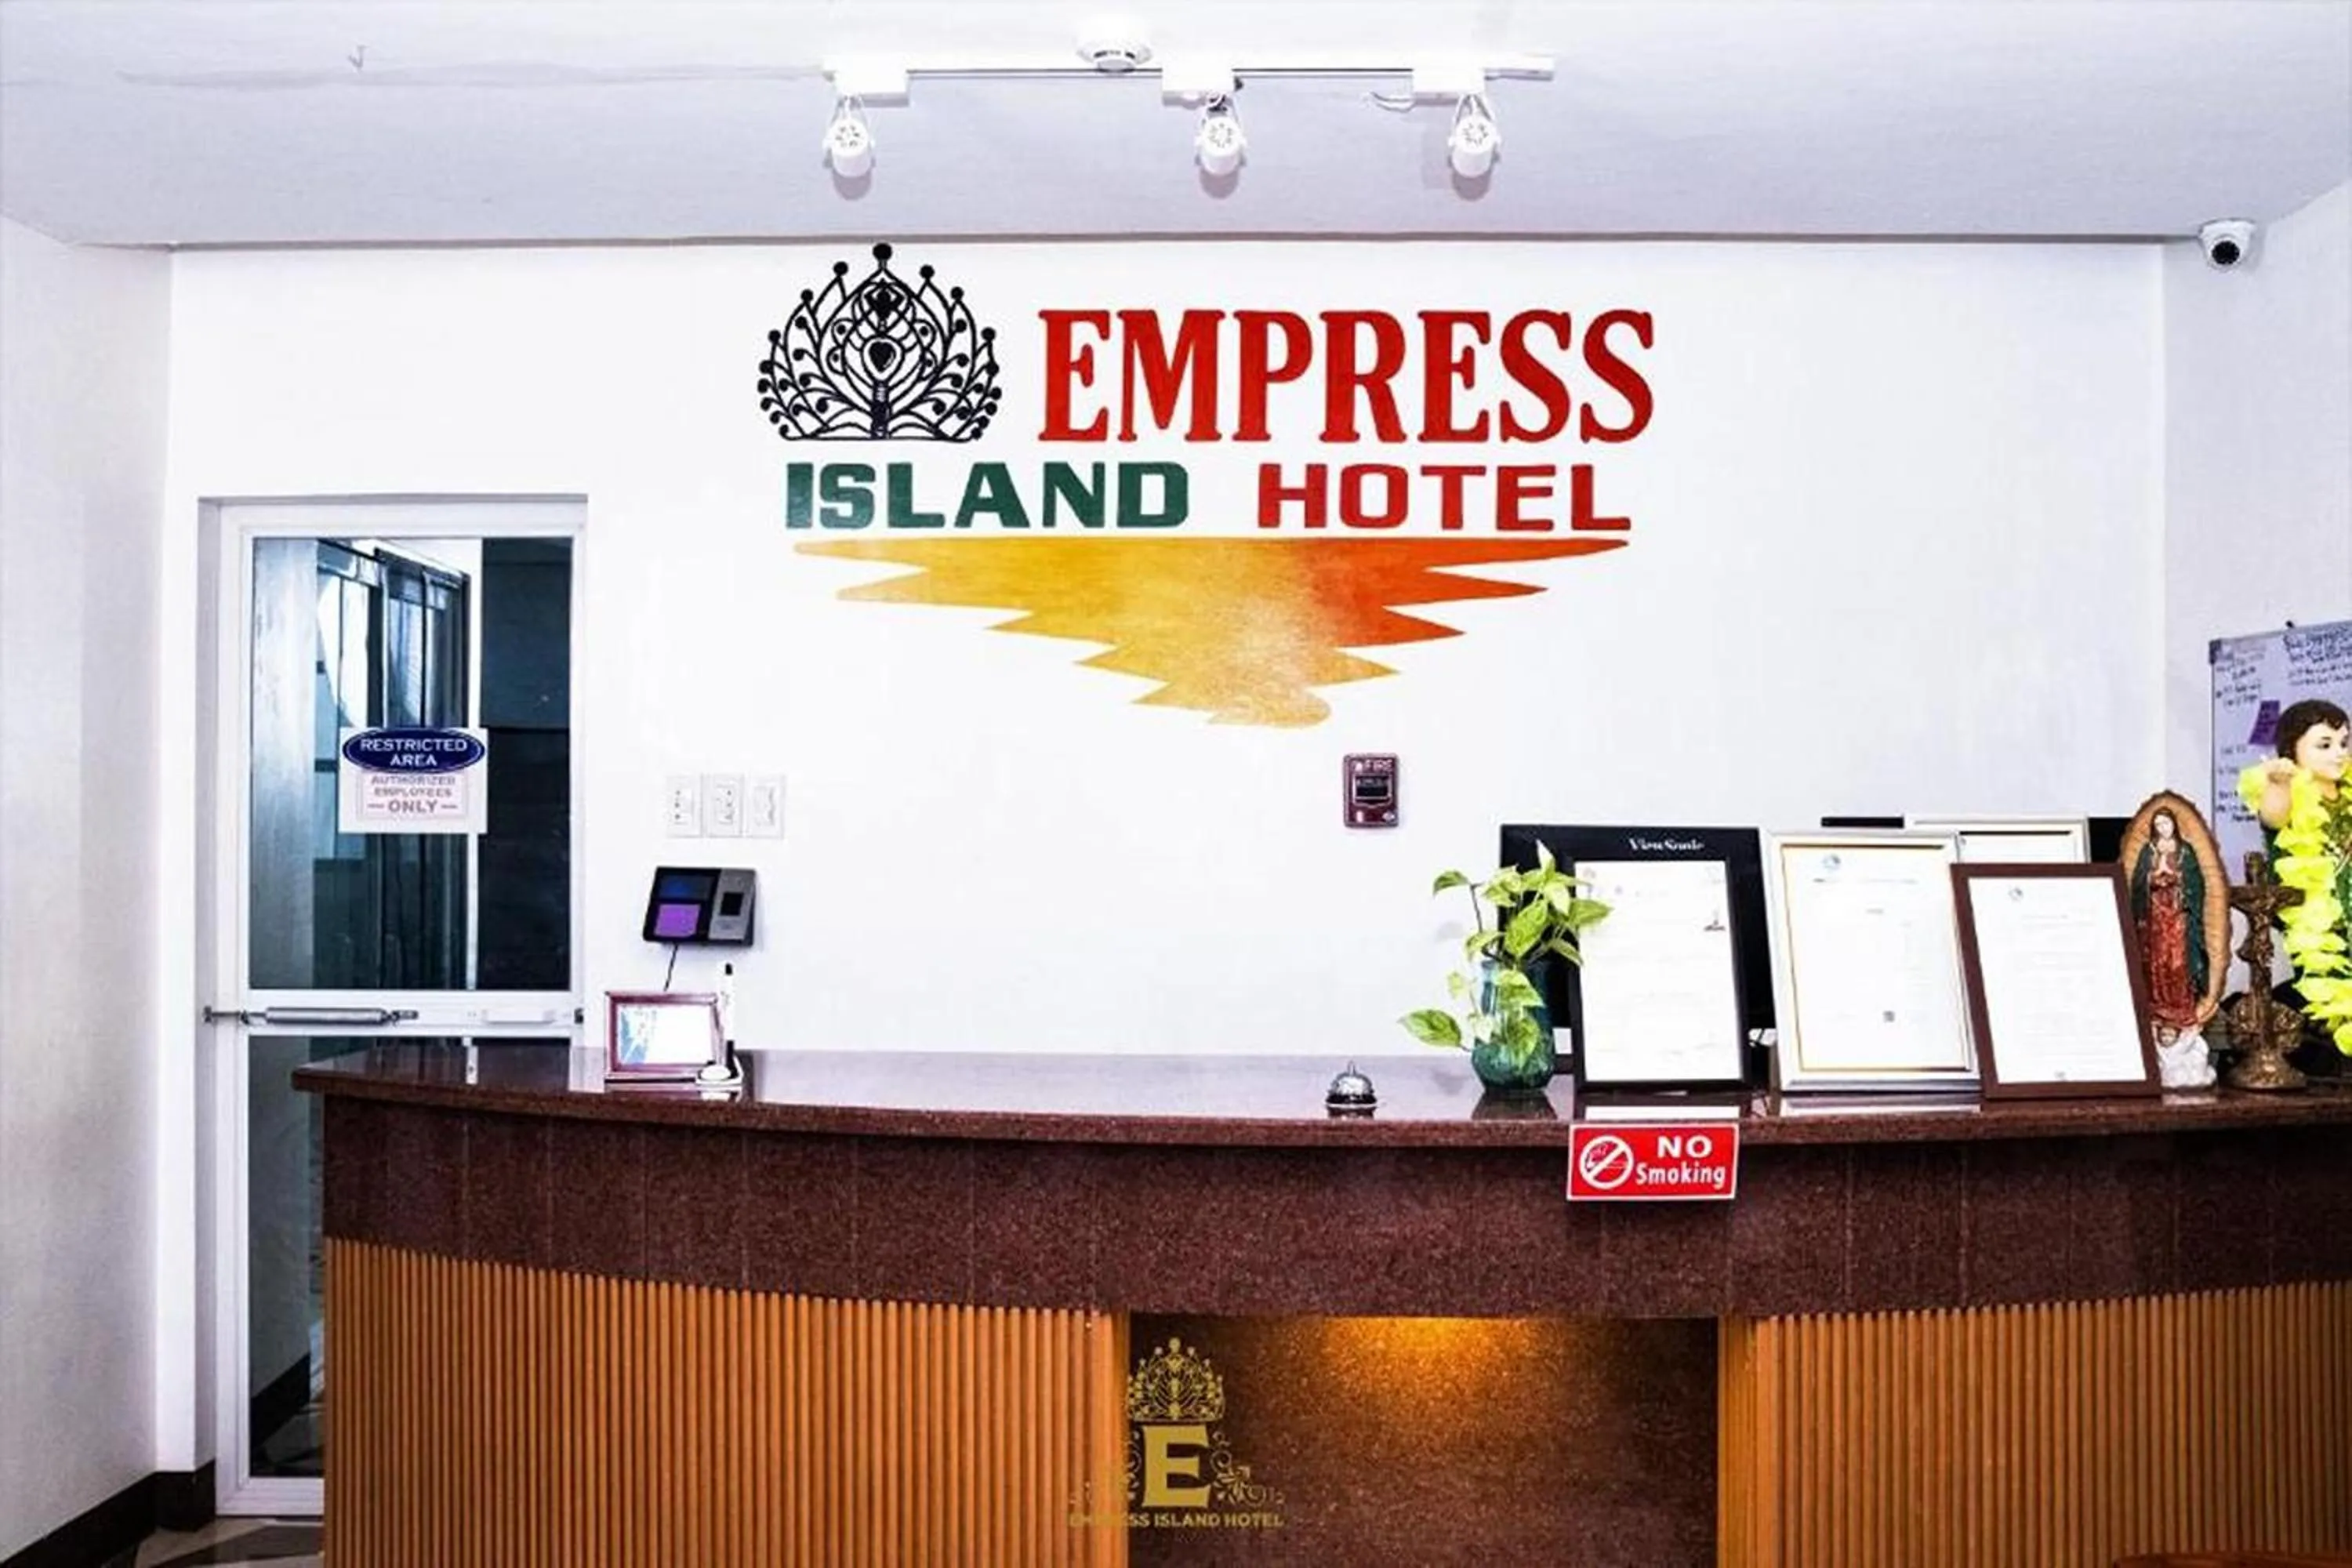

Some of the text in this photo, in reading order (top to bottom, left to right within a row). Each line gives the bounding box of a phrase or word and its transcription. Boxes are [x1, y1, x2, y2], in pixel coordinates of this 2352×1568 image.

[1038, 310, 1653, 443] EMPRESS
[788, 463, 1631, 531] ISLAND HOTEL
[361, 738, 468, 752] RESTRICTED
[390, 753, 437, 767] AREA
[371, 775, 456, 786] AUTHORIZED
[374, 787, 452, 798] EMPLOYEES
[387, 799, 438, 814] ONLY
[1657, 1135, 1712, 1158] NO
[1636, 1161, 1726, 1189] Smoking
